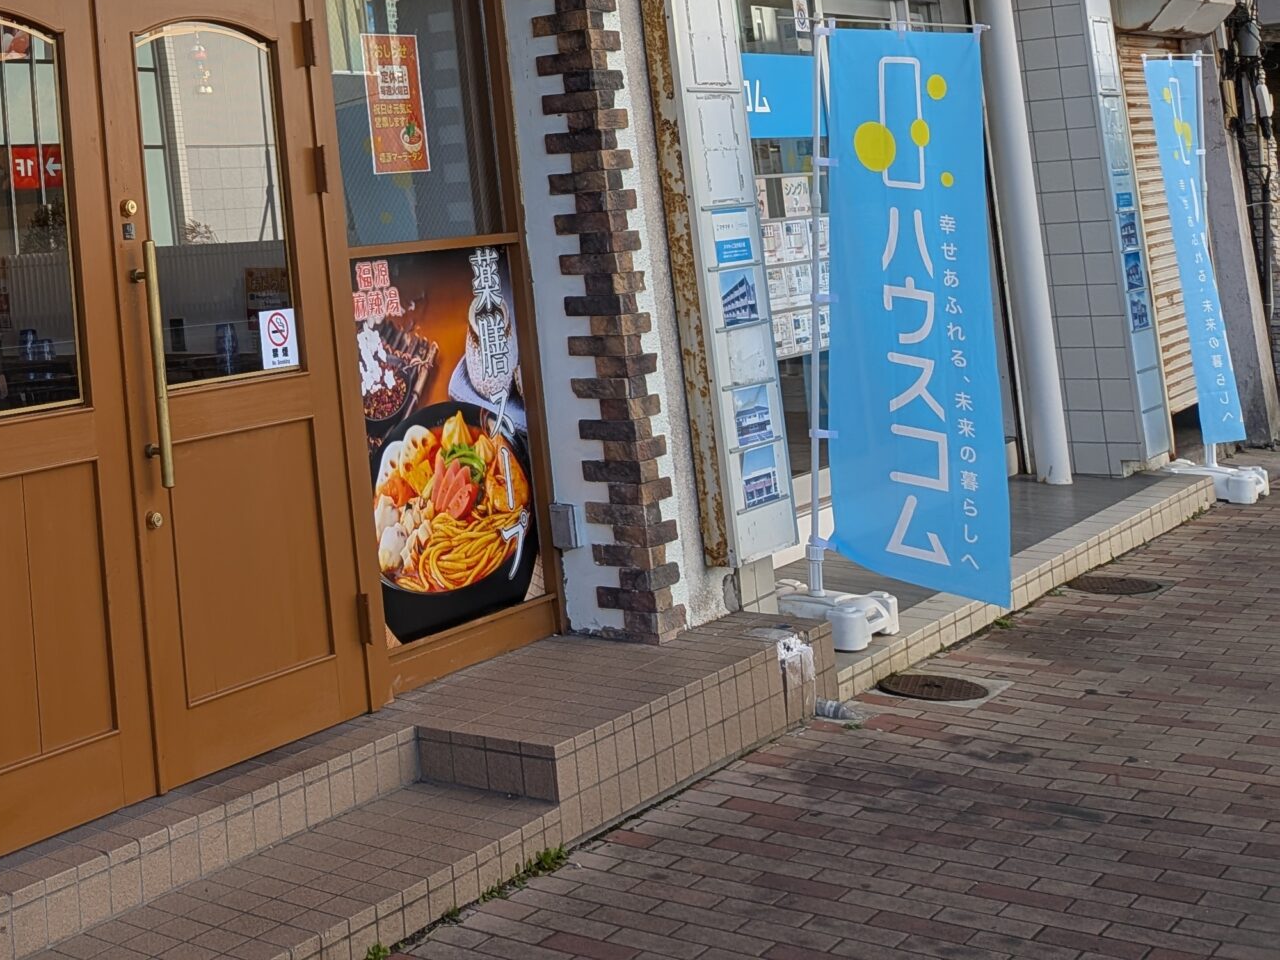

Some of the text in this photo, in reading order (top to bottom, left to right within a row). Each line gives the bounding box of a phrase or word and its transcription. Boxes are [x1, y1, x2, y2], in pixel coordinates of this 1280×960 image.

[468, 246, 529, 581] 薬膳スープ
[880, 206, 952, 567] ハウスコム
[937, 214, 980, 571] 幸せあふれる、未来の暮らしへ
